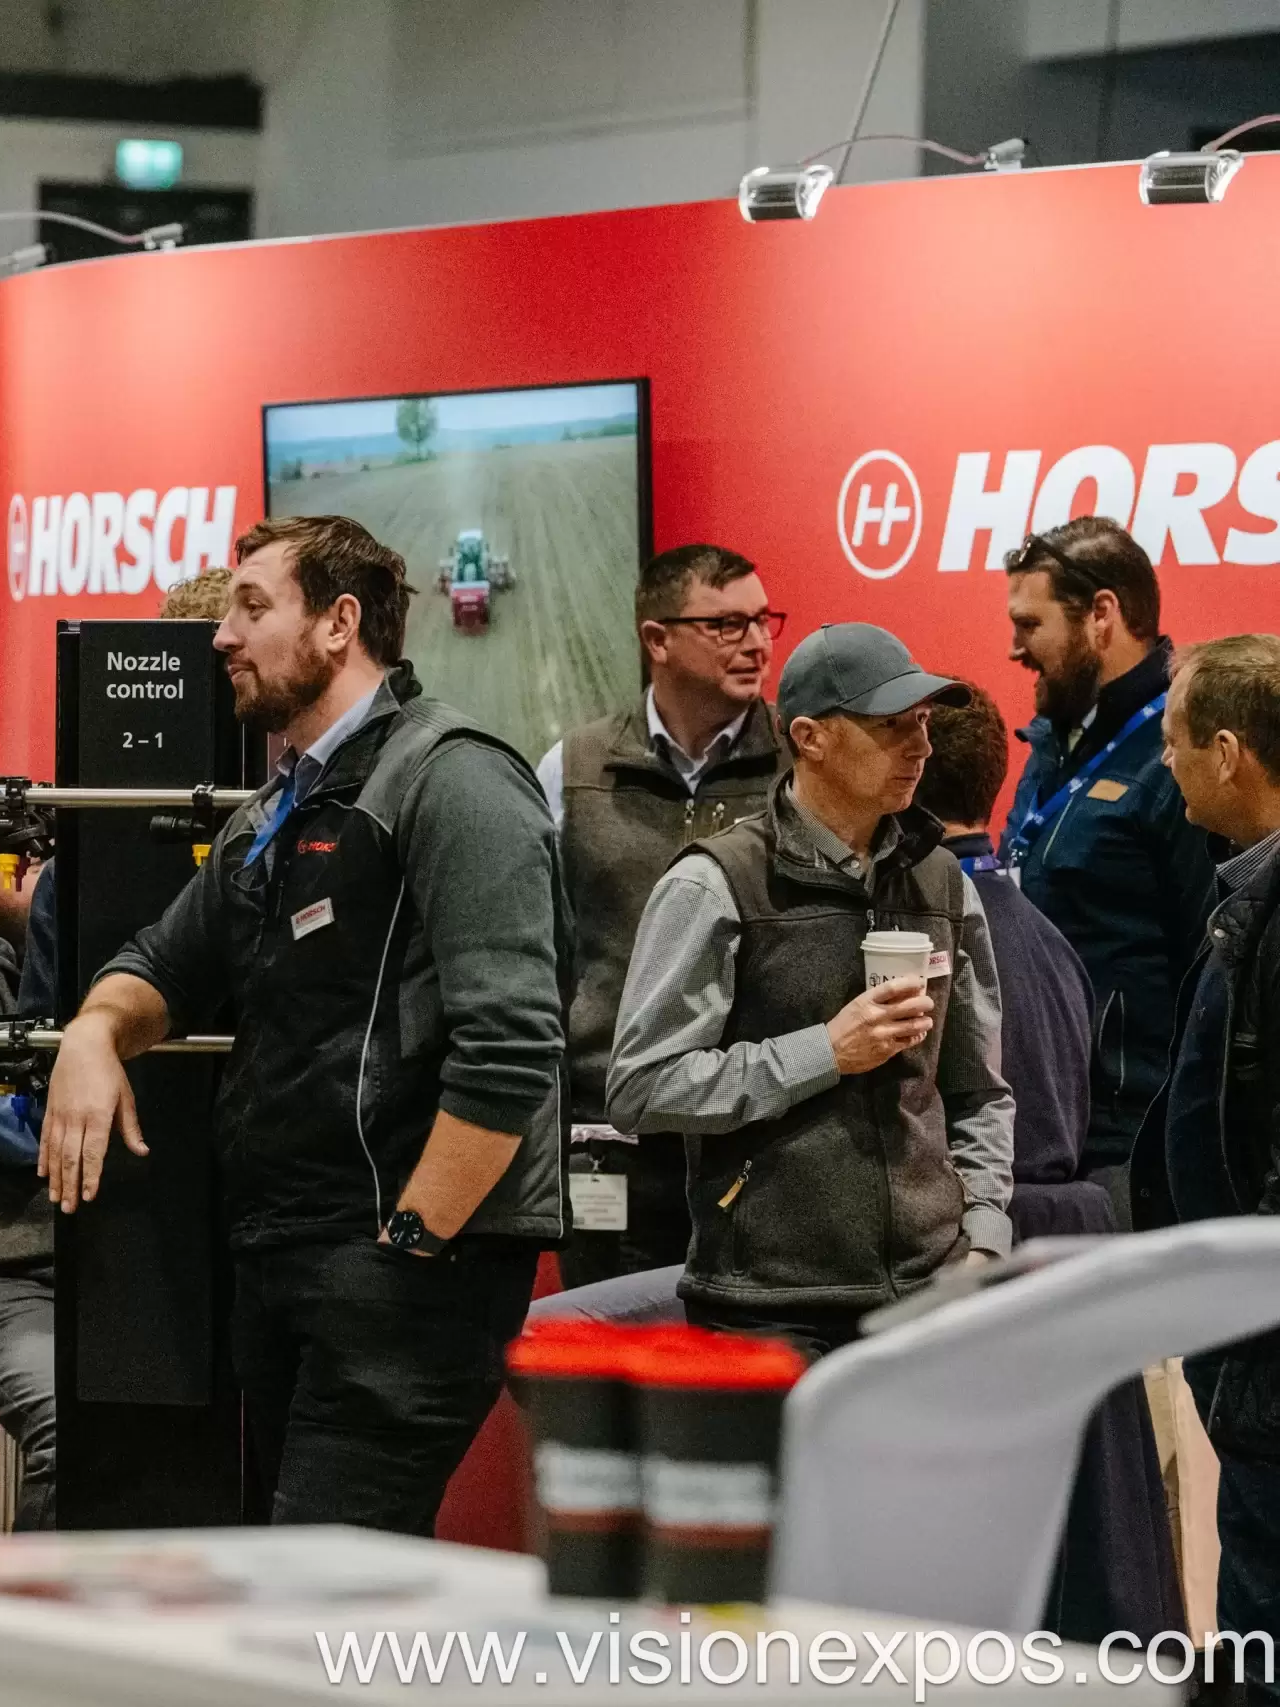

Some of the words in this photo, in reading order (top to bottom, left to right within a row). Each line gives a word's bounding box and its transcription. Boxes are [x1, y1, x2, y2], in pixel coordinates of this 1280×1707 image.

[28, 485, 237, 596] HORSCH
[107, 651, 181, 671] Nozzle
[106, 679, 184, 699] control
